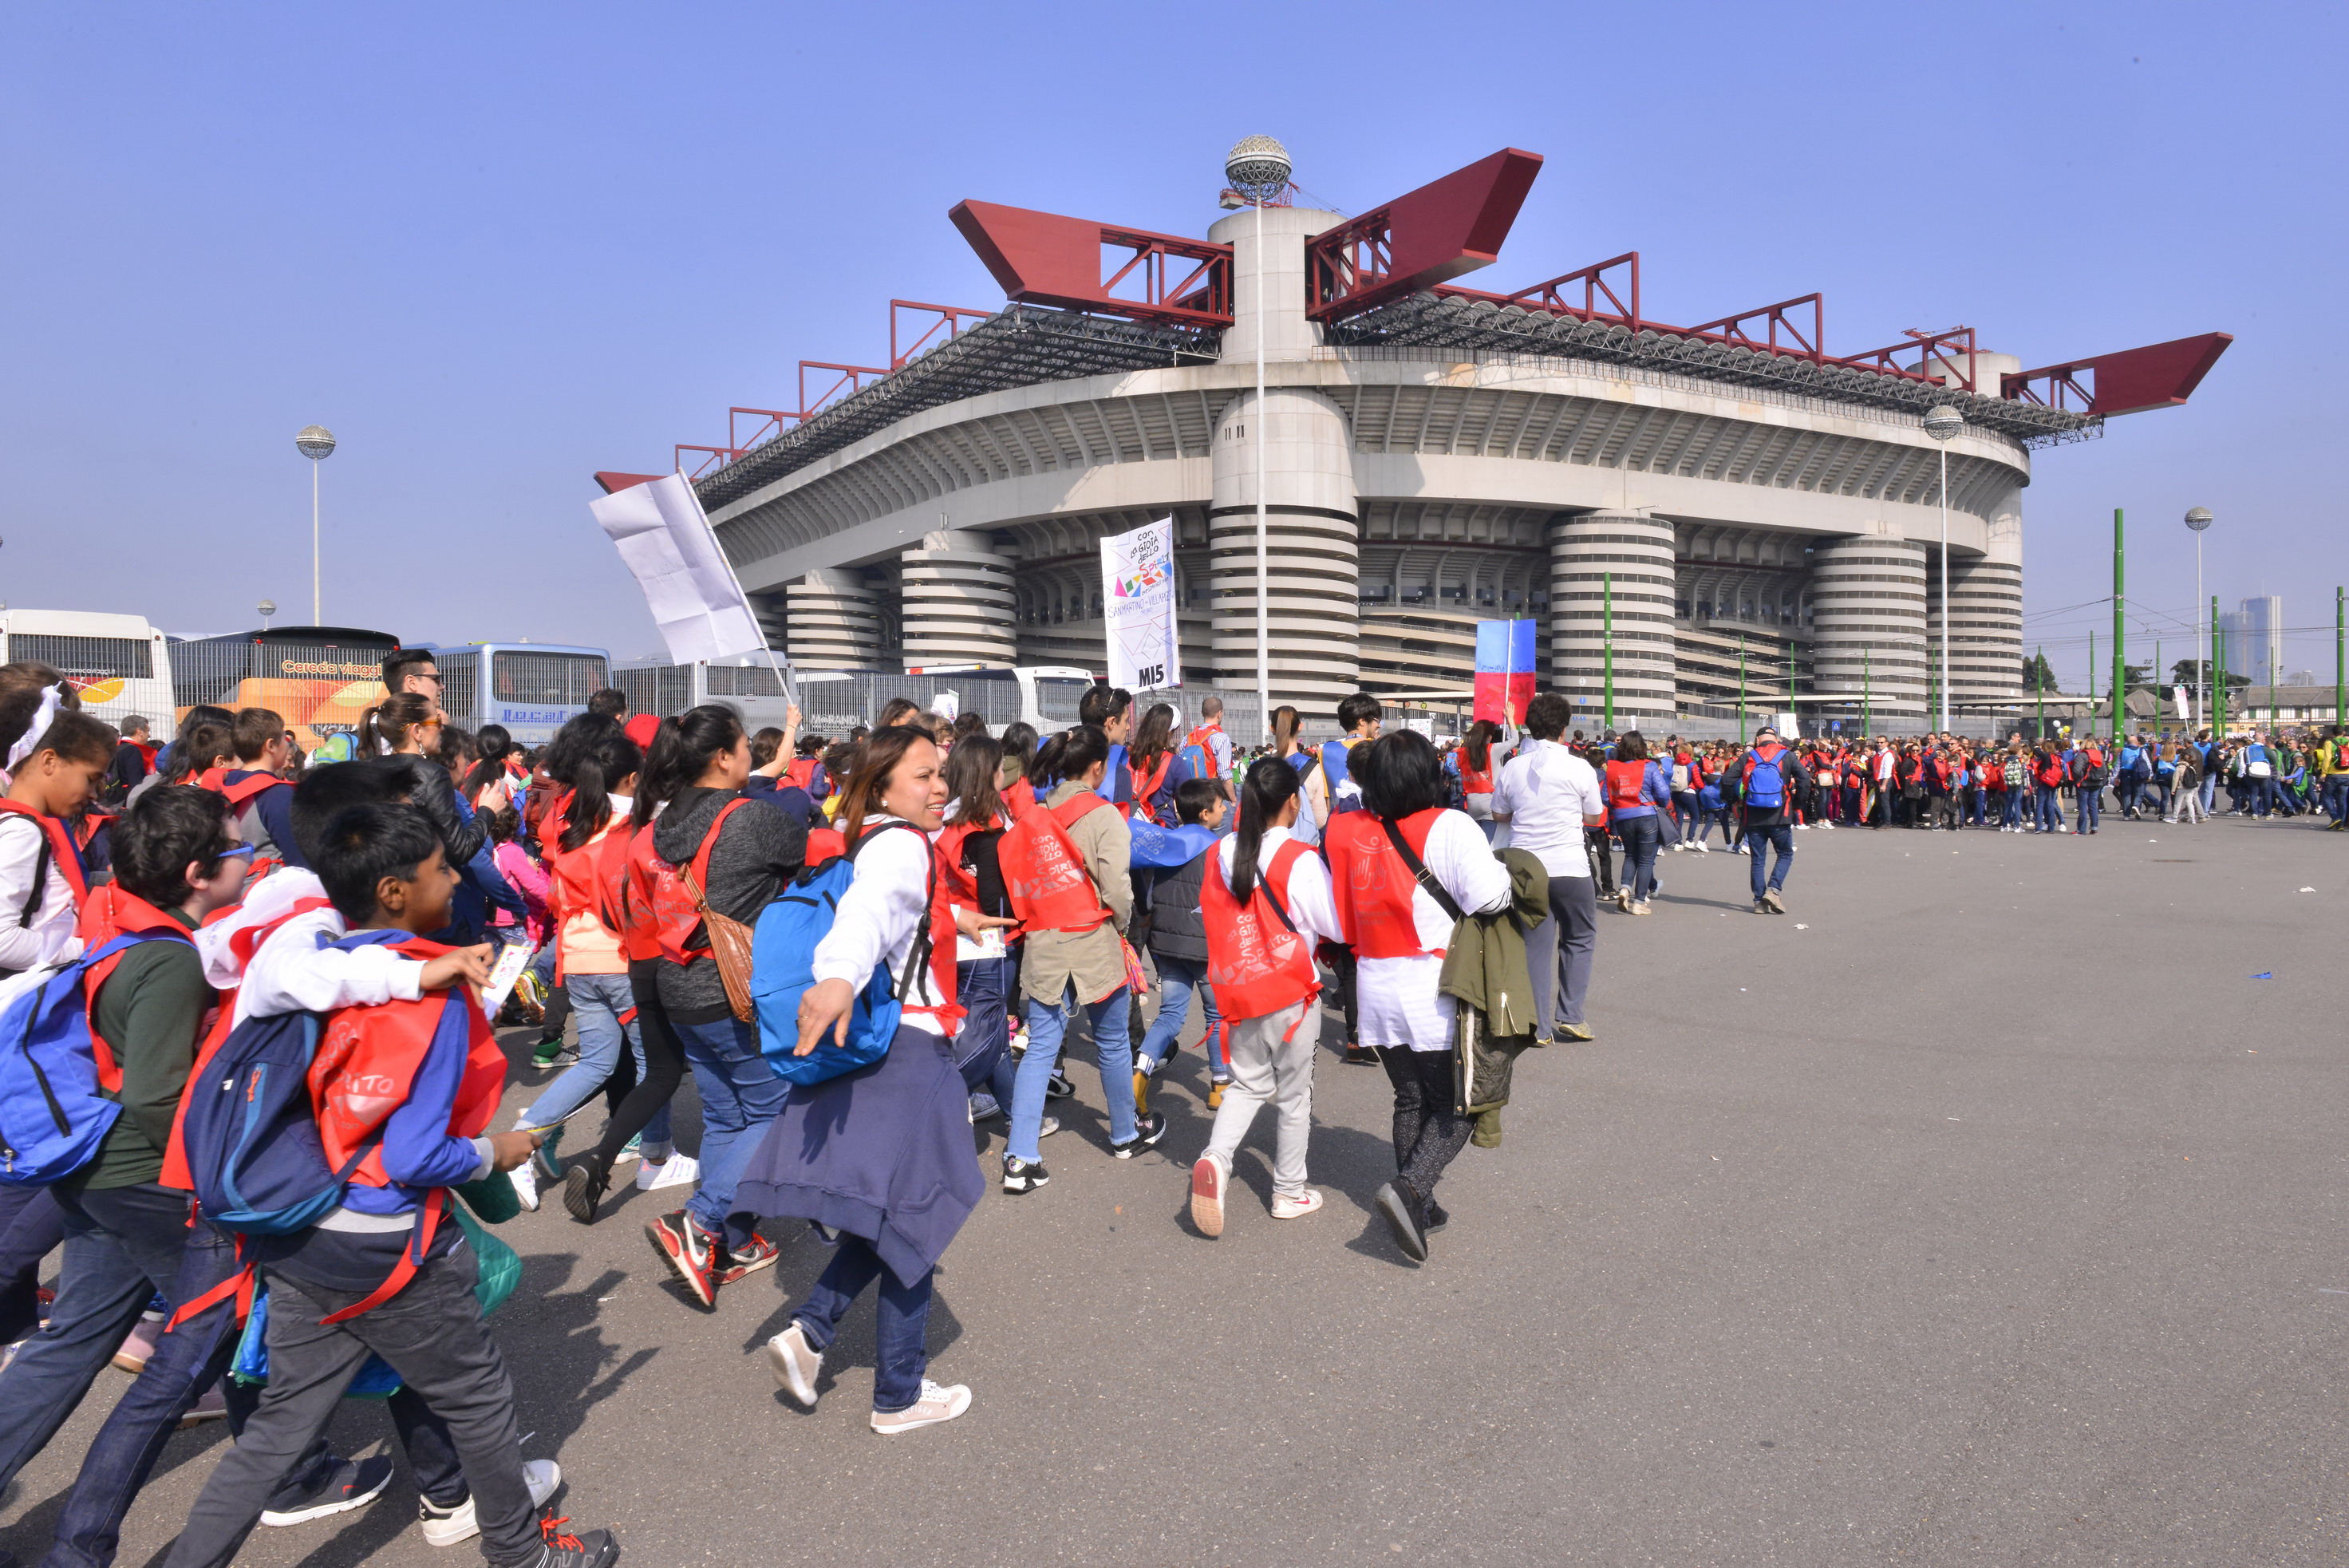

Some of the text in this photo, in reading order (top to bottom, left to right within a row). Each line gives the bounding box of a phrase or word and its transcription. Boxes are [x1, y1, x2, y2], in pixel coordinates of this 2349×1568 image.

[282, 660, 383, 678] Cereda viaggi
[1139, 663, 1164, 688] MI5
